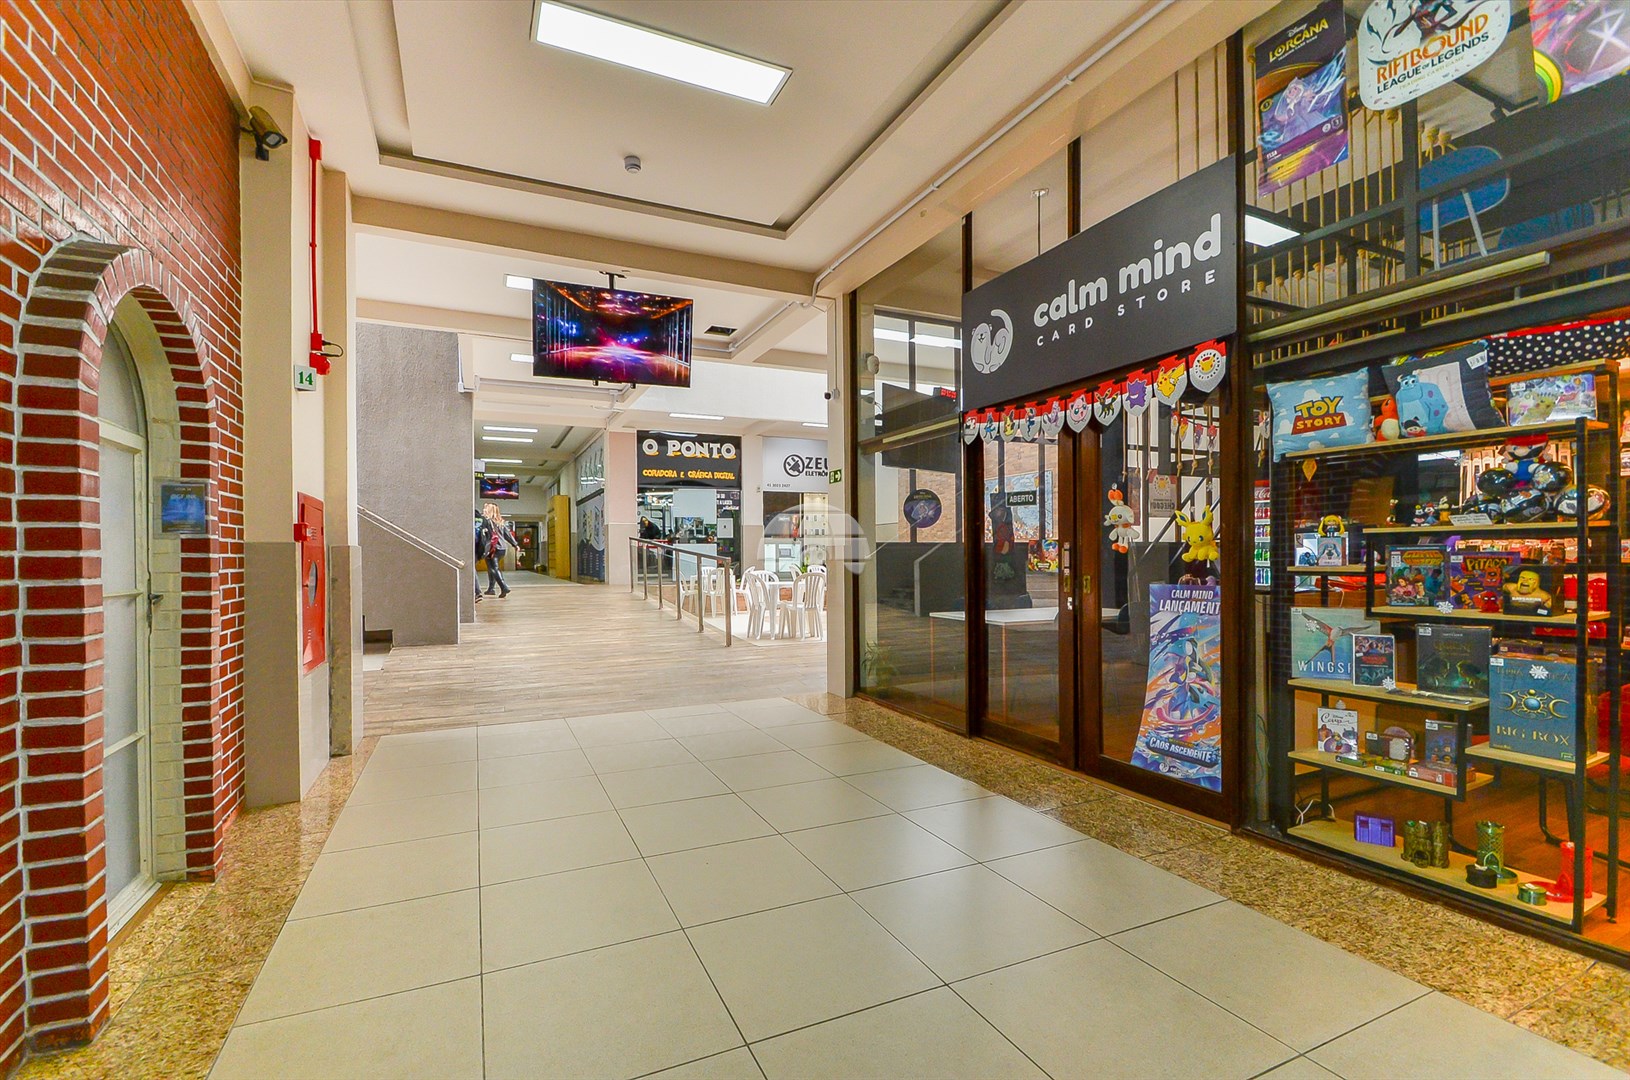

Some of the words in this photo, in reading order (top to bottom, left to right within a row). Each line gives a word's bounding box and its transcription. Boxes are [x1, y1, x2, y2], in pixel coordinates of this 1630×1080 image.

[1268, 18, 1329, 63] LORCANA
[1377, 13, 1489, 85] RIFTBOUND
[1377, 64, 1422, 94] LEAGUE
[1431, 32, 1489, 68] LEGENDS
[1033, 277, 1108, 327] calm
[1119, 213, 1221, 294] mind
[1036, 317, 1093, 346] CARD
[1117, 269, 1216, 316] STORE
[298, 371, 314, 386] 14
[1294, 396, 1343, 419] TOY
[1296, 415, 1342, 430] STORY
[642, 438, 659, 456] O
[666, 440, 737, 459] PONTO
[642, 468, 678, 478] COPIADORA
[687, 468, 713, 479] GRÁFICA
[713, 471, 736, 480] DIGITAL
[1010, 494, 1034, 503] ABERTO
[1171, 589, 1191, 599] CALM
[1191, 590, 1214, 600] MIND
[1159, 600, 1221, 615] LANÇAMENT
[1532, 730, 1569, 746] BOX
[1149, 737, 1170, 751] CAOS
[1170, 744, 1213, 762] ASCENDENTE
